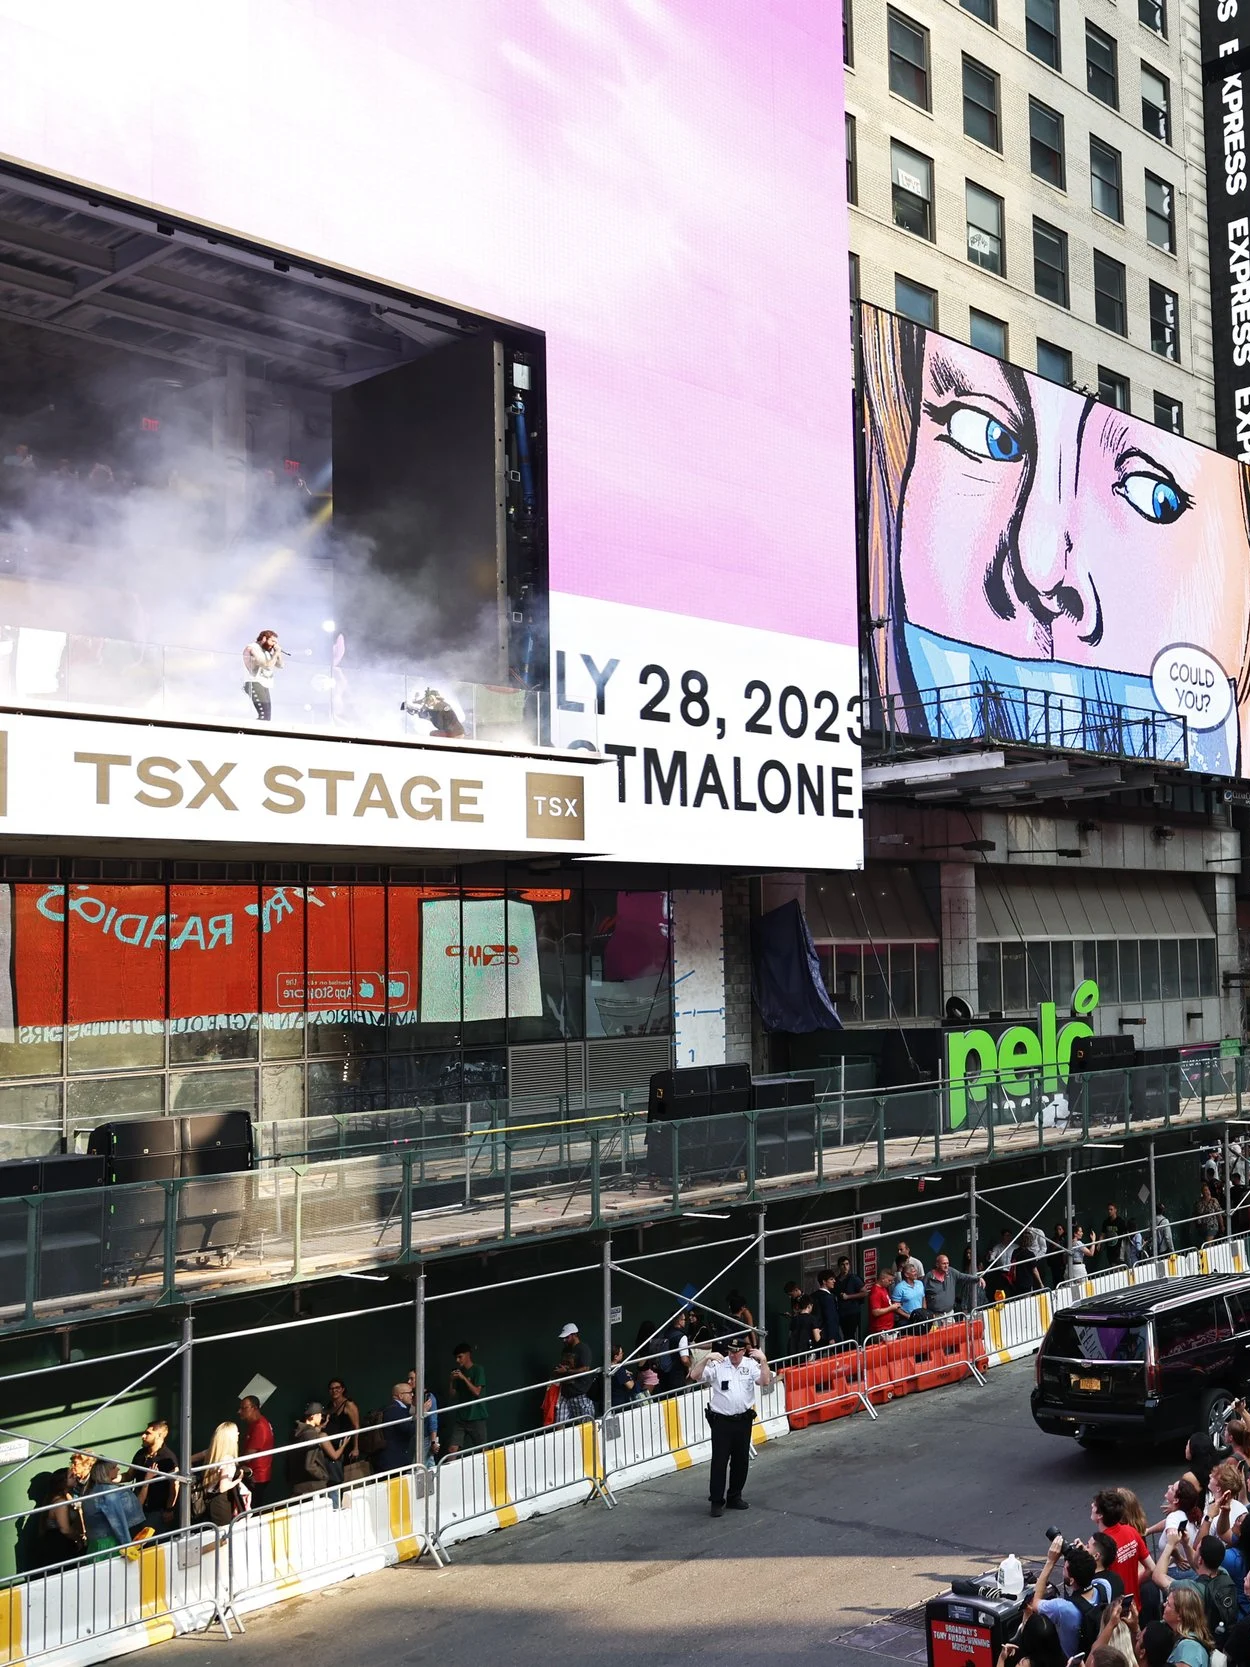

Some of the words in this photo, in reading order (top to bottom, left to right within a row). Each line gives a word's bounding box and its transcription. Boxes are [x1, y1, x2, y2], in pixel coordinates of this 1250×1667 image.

[1169, 662, 1215, 688] COULD
[638, 664, 726, 740] 28,
[744, 679, 862, 746] 2023
[1174, 687, 1212, 714] YOU?
[73, 751, 240, 812] TSX
[262, 764, 485, 824] STAGE
[534, 795, 579, 820] TSX
[933, 1630, 947, 1640] TONY
[948, 1633, 991, 1648] AWARD-WINNING
[945, 1624, 978, 1637] BROADWAY'S
[951, 1642, 975, 1654] MUSICAL
